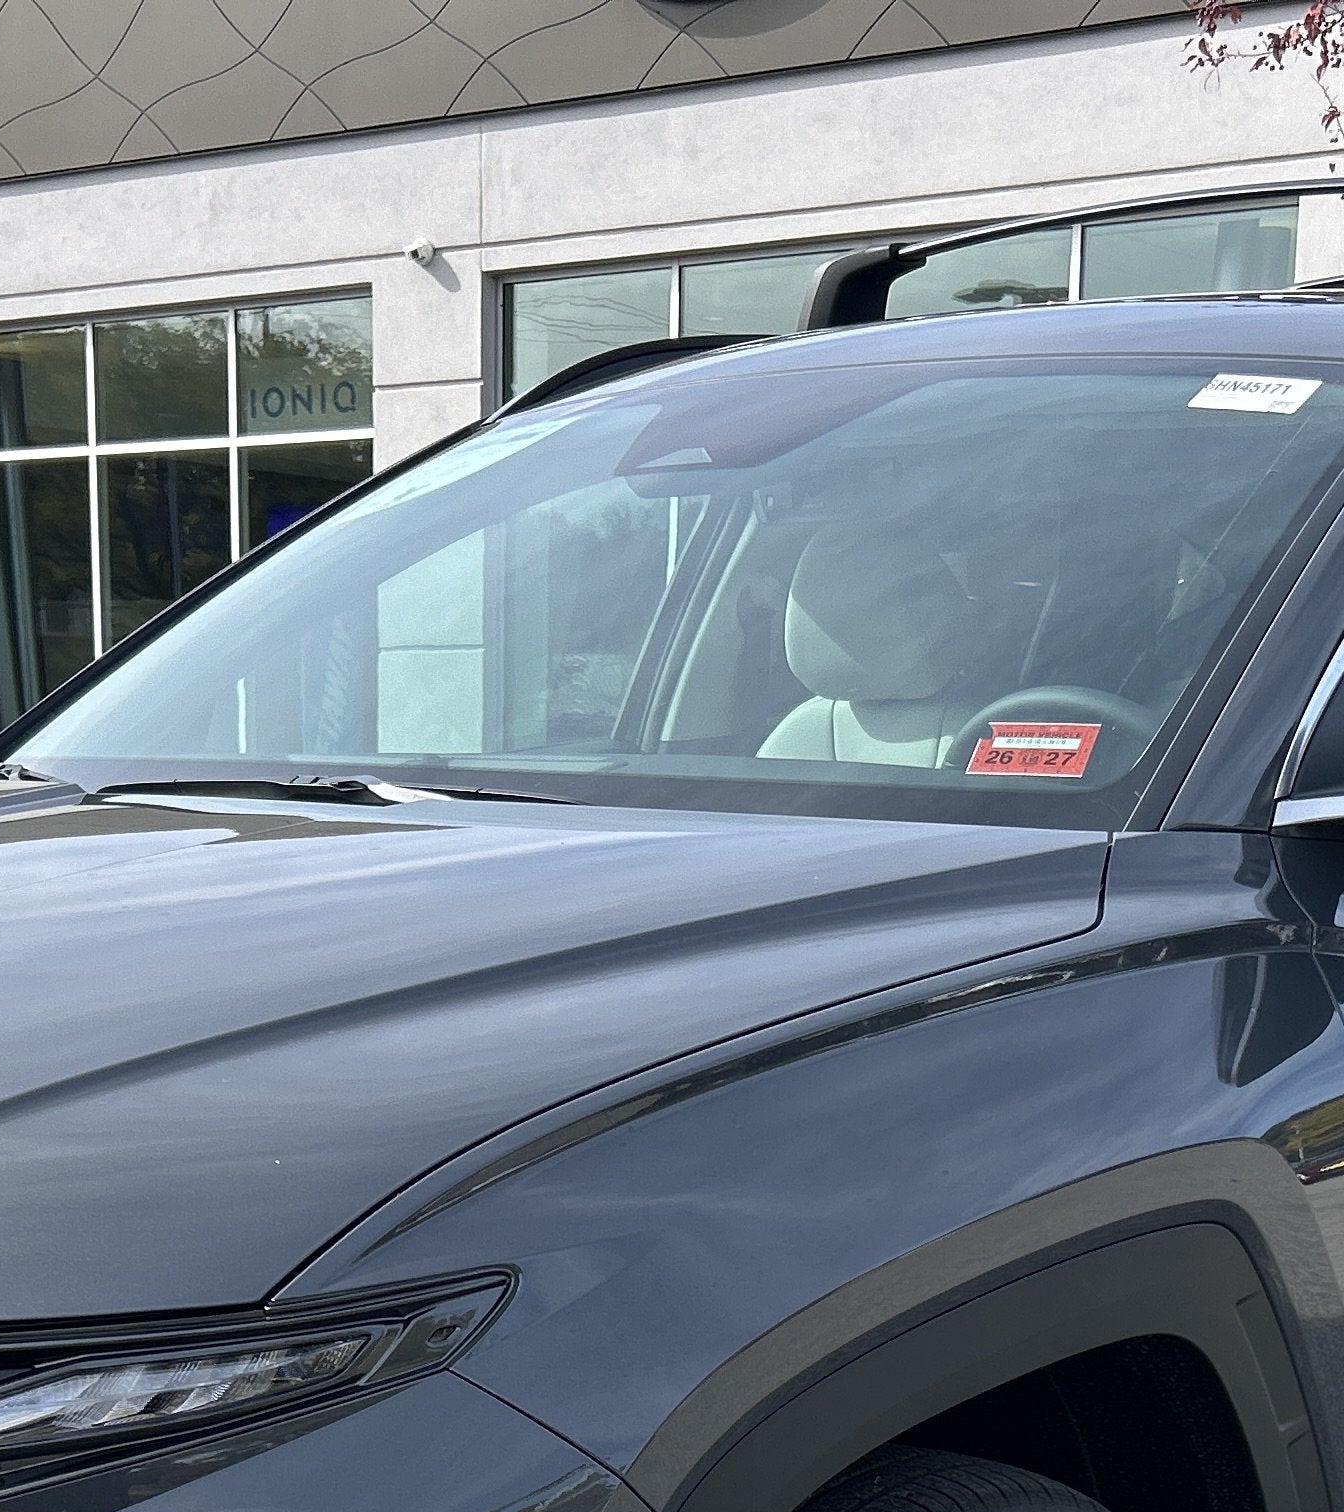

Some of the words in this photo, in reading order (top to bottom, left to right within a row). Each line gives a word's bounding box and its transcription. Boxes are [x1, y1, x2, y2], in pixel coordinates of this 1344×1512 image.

[249, 381, 357, 419] IONIQ
[984, 750, 1015, 765] 26
[1043, 751, 1077, 766] 27
